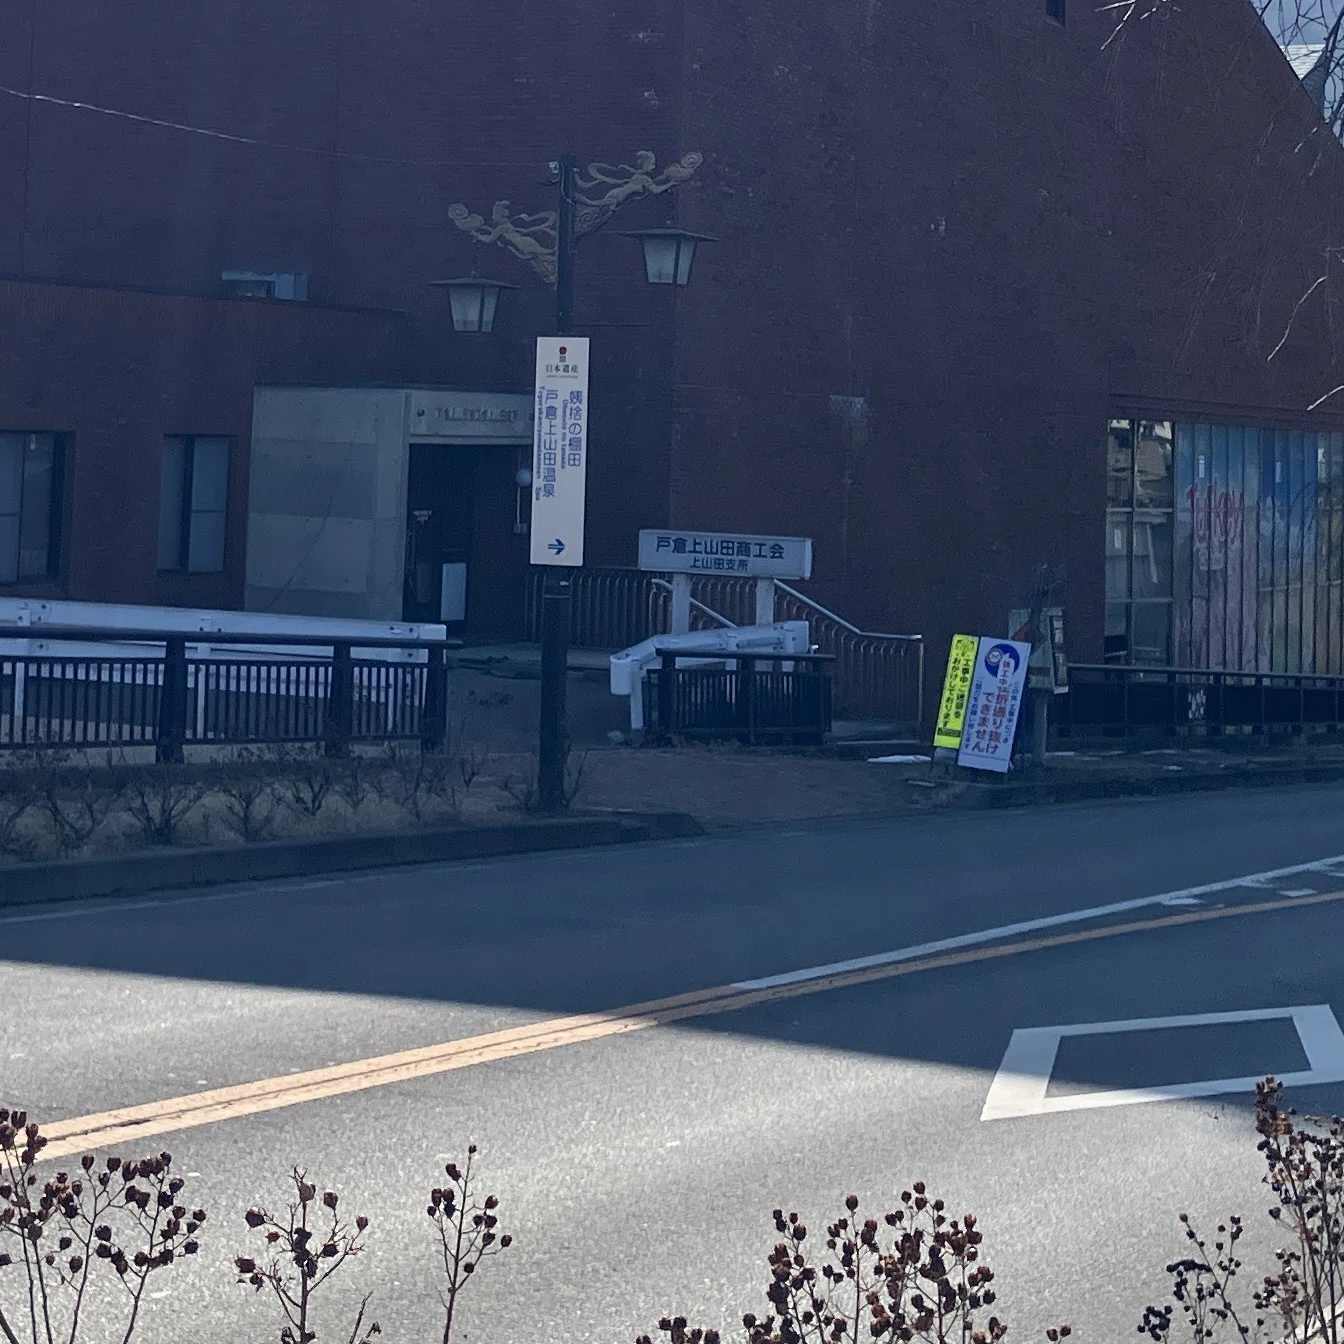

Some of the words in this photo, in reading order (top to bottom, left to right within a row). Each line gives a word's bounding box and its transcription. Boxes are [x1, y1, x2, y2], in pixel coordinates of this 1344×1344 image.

[546, 364, 579, 374] 日本遺産
[543, 389, 559, 498] 戸倉上山田温泉
[568, 390, 583, 467] 姨捨の棚田
[656, 536, 785, 560] 戸倉上山田商工会
[690, 557, 749, 572] 上山田支所
[971, 692, 996, 753] できません
